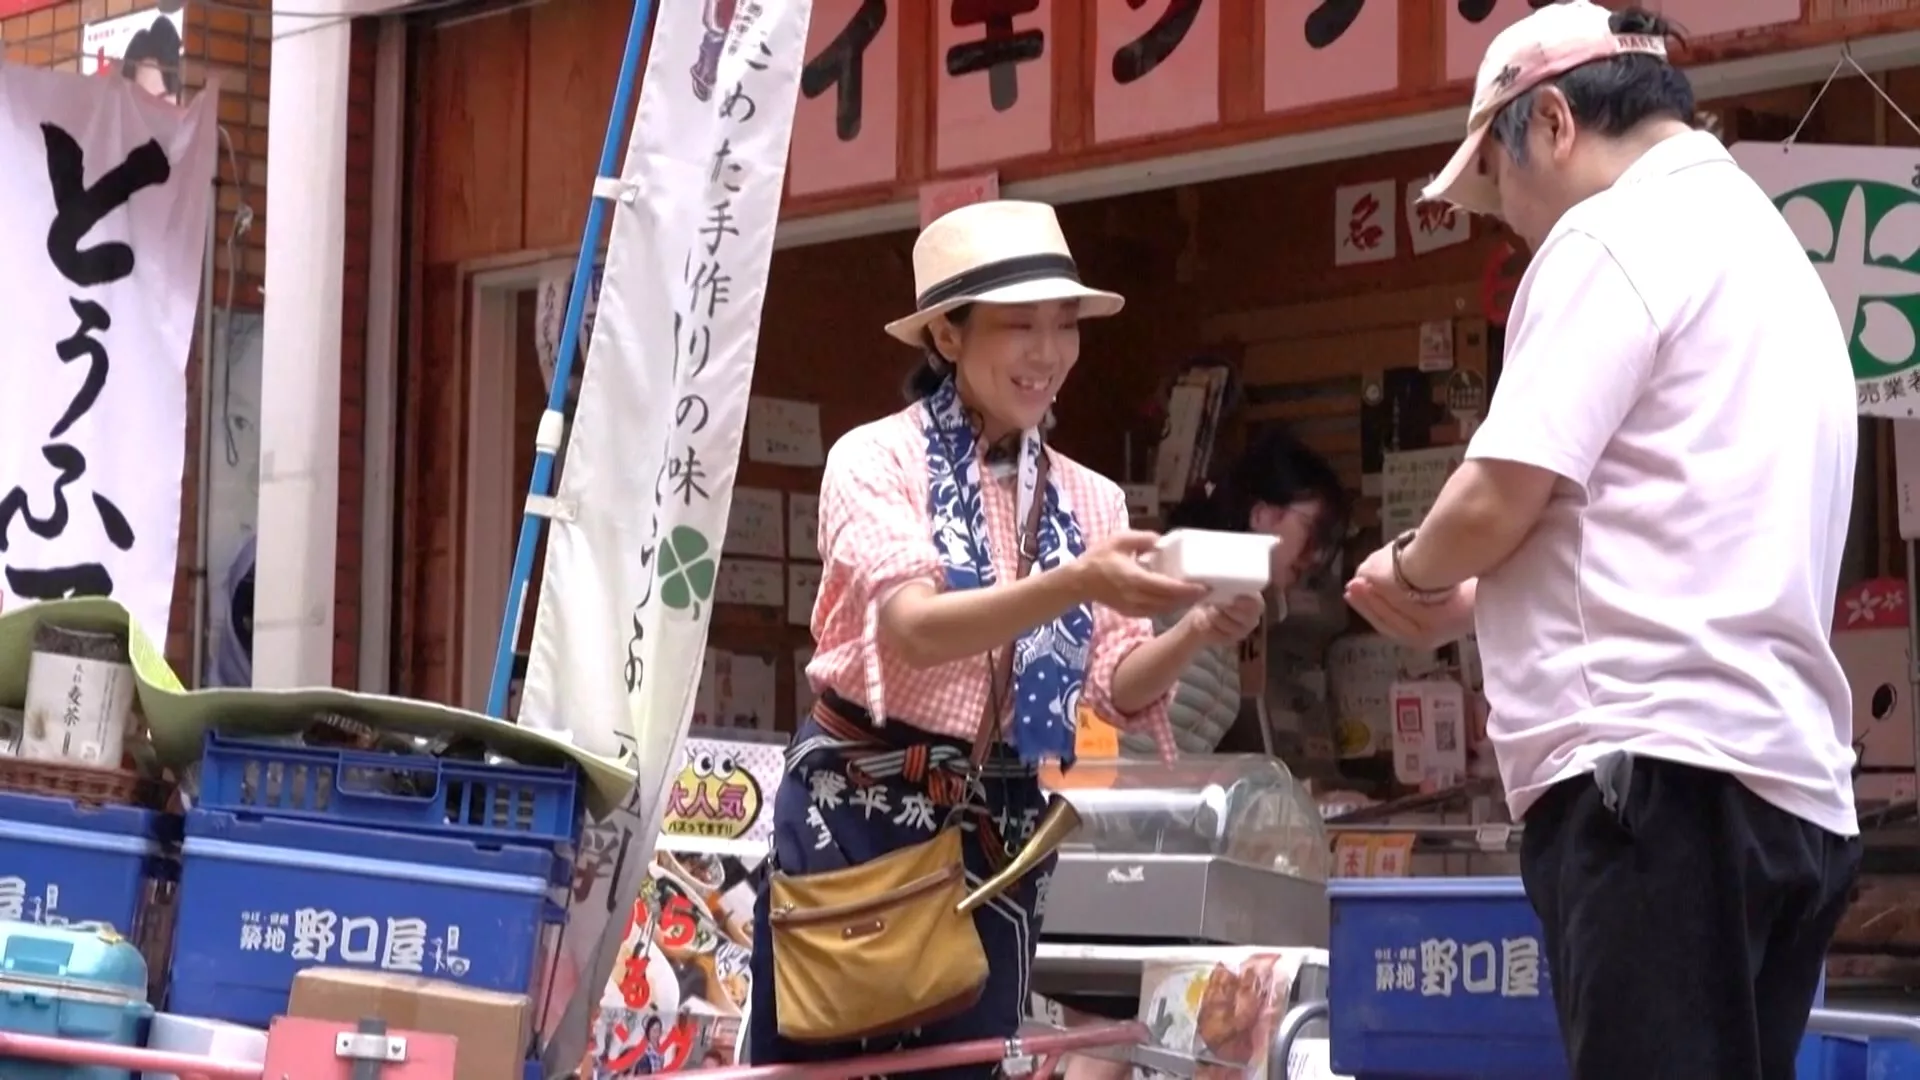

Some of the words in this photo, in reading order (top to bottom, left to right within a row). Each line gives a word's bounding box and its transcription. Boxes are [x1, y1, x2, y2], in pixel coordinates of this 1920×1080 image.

[664, 780, 748, 822] 大人気
[291, 906, 428, 972] 野口屋
[1420, 936, 1540, 998] 野口屋
